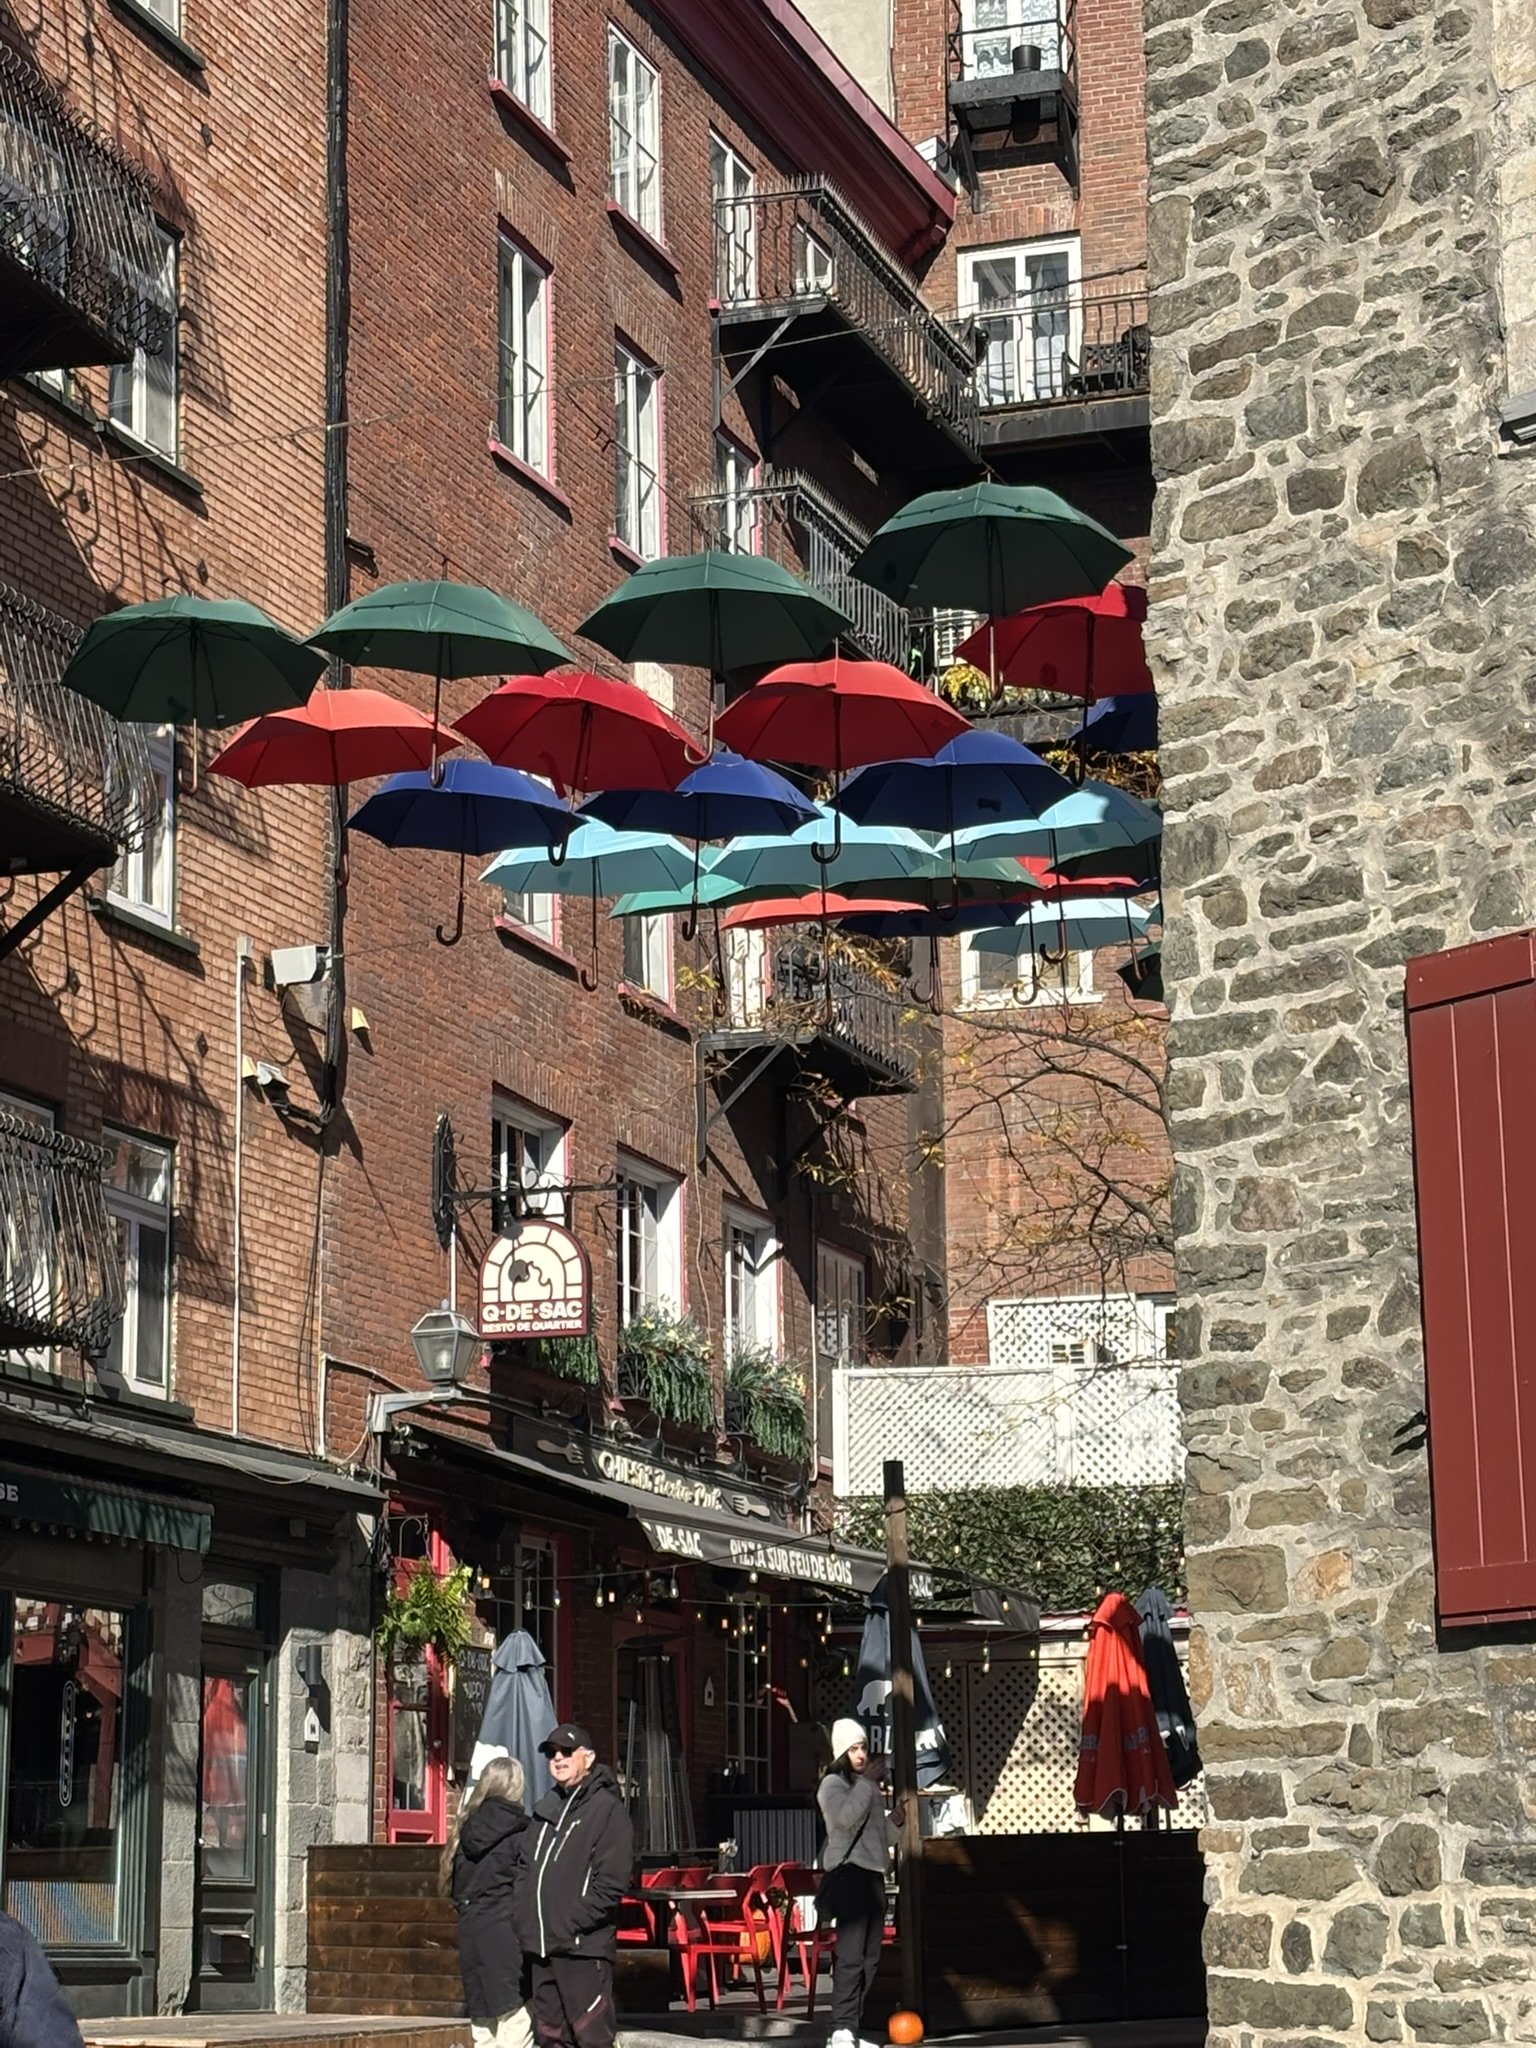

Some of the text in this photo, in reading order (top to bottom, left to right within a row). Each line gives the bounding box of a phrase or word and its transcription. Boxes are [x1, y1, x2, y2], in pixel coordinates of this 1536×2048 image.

[482, 1319, 582, 1334] RESTO DE QUARTIER
[730, 1539, 853, 1585] PIZZA SUR FEU DE BOIS
